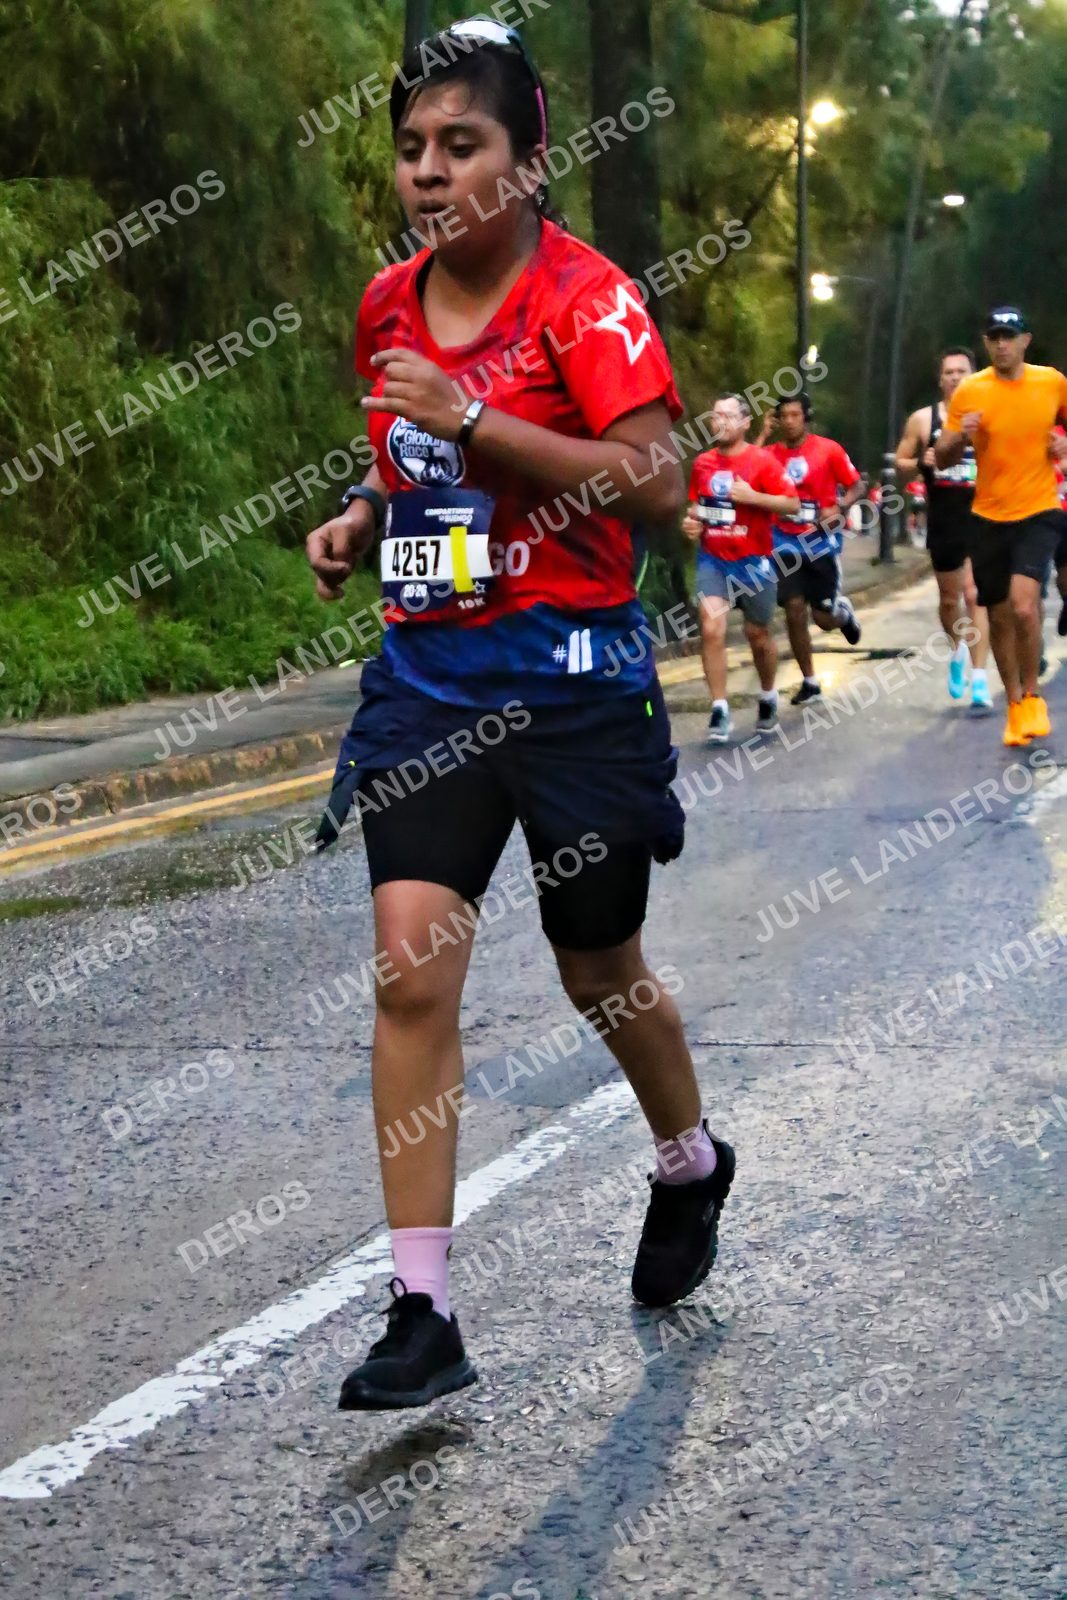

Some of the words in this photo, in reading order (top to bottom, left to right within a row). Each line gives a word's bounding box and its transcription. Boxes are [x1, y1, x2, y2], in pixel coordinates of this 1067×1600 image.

[399, 442, 430, 458] Race
[392, 540, 441, 577] 4257
[457, 597, 486, 610] 10K
